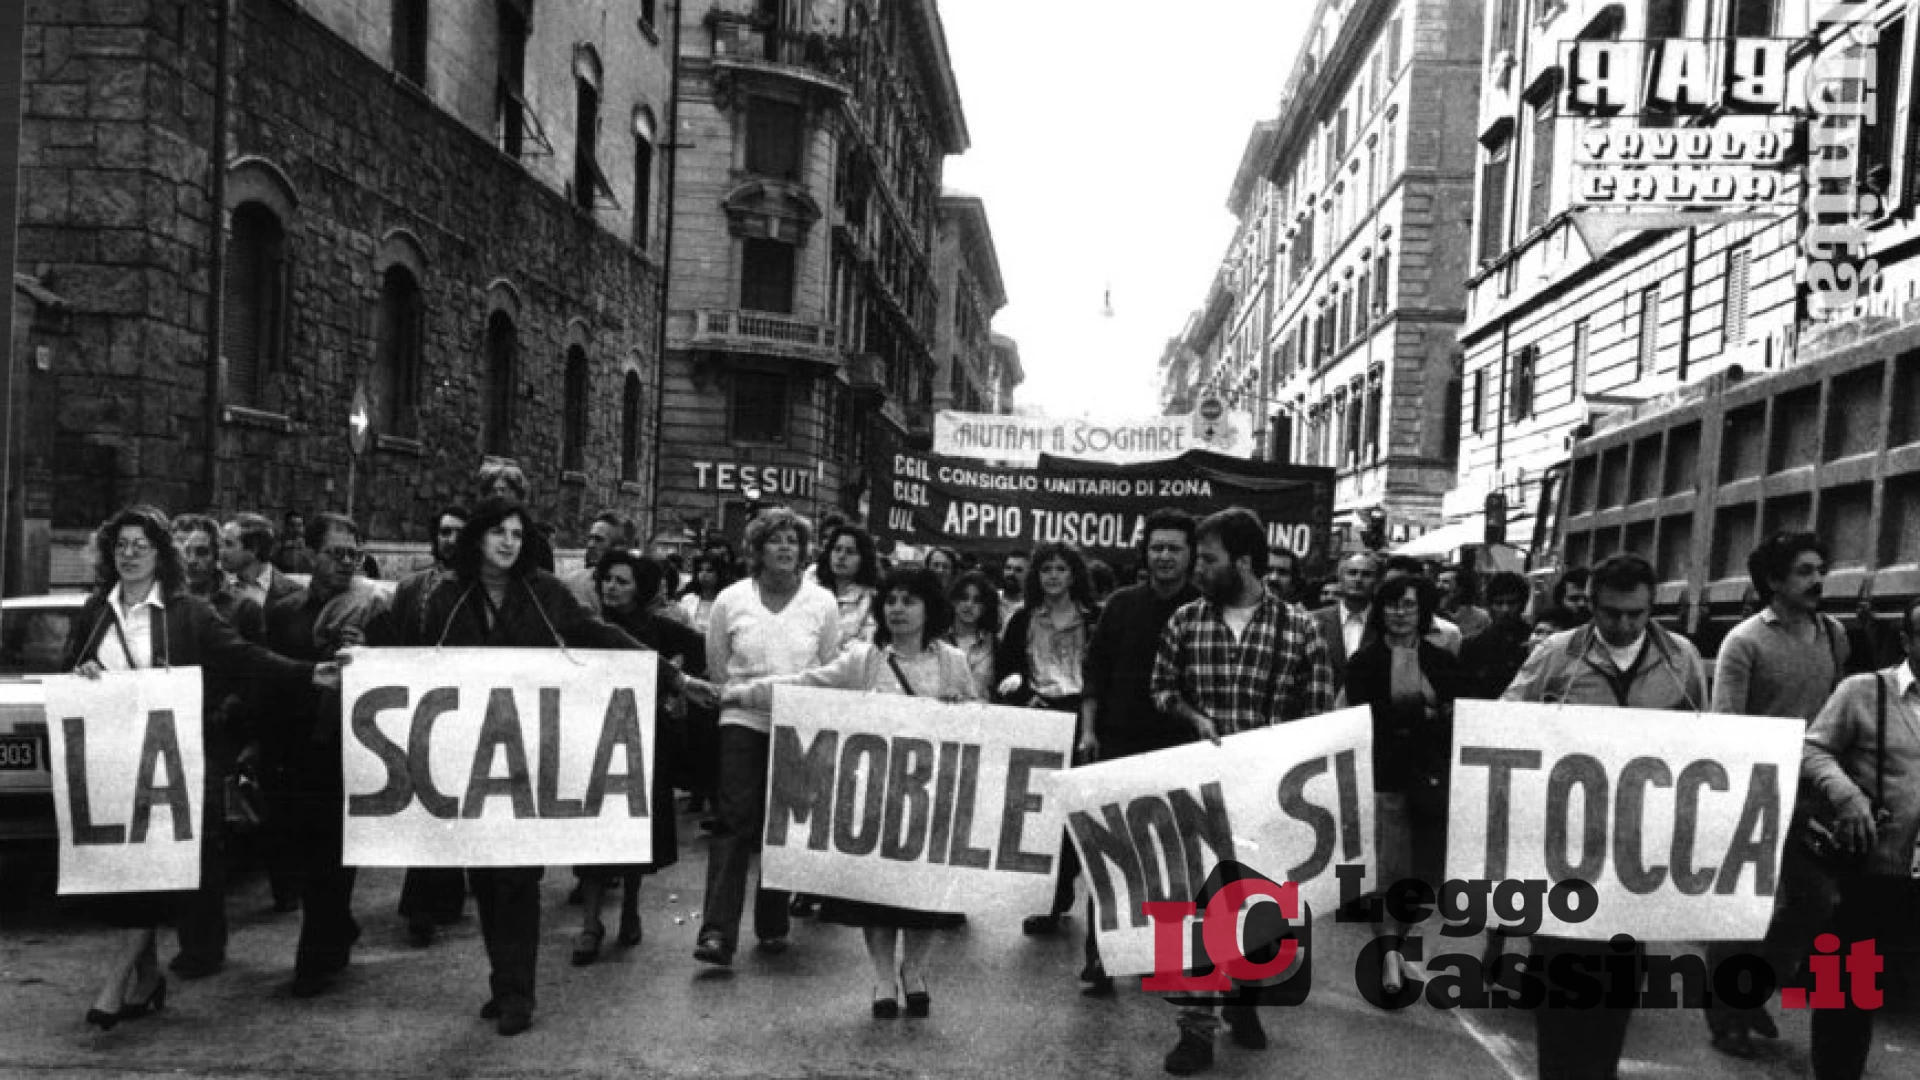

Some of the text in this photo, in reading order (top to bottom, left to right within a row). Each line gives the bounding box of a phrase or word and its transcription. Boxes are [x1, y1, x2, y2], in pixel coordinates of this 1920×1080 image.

[1580, 127, 1781, 160] TAVOLA
[1581, 172, 1778, 202] CALDA
[894, 454, 931, 481] CGIL
[938, 466, 1212, 497] CONSIGLIO UNITARIO DI ZONA
[942, 501, 1022, 539] APPIO
[1030, 508, 1146, 548] TUSCOLA
[1266, 521, 1311, 558] INO
[62, 709, 194, 847] LA
[348, 685, 649, 820] SCALA
[765, 725, 1065, 875] MOBILE
[1068, 749, 1364, 931] NON SI
[1459, 745, 1781, 896] TOCCA
